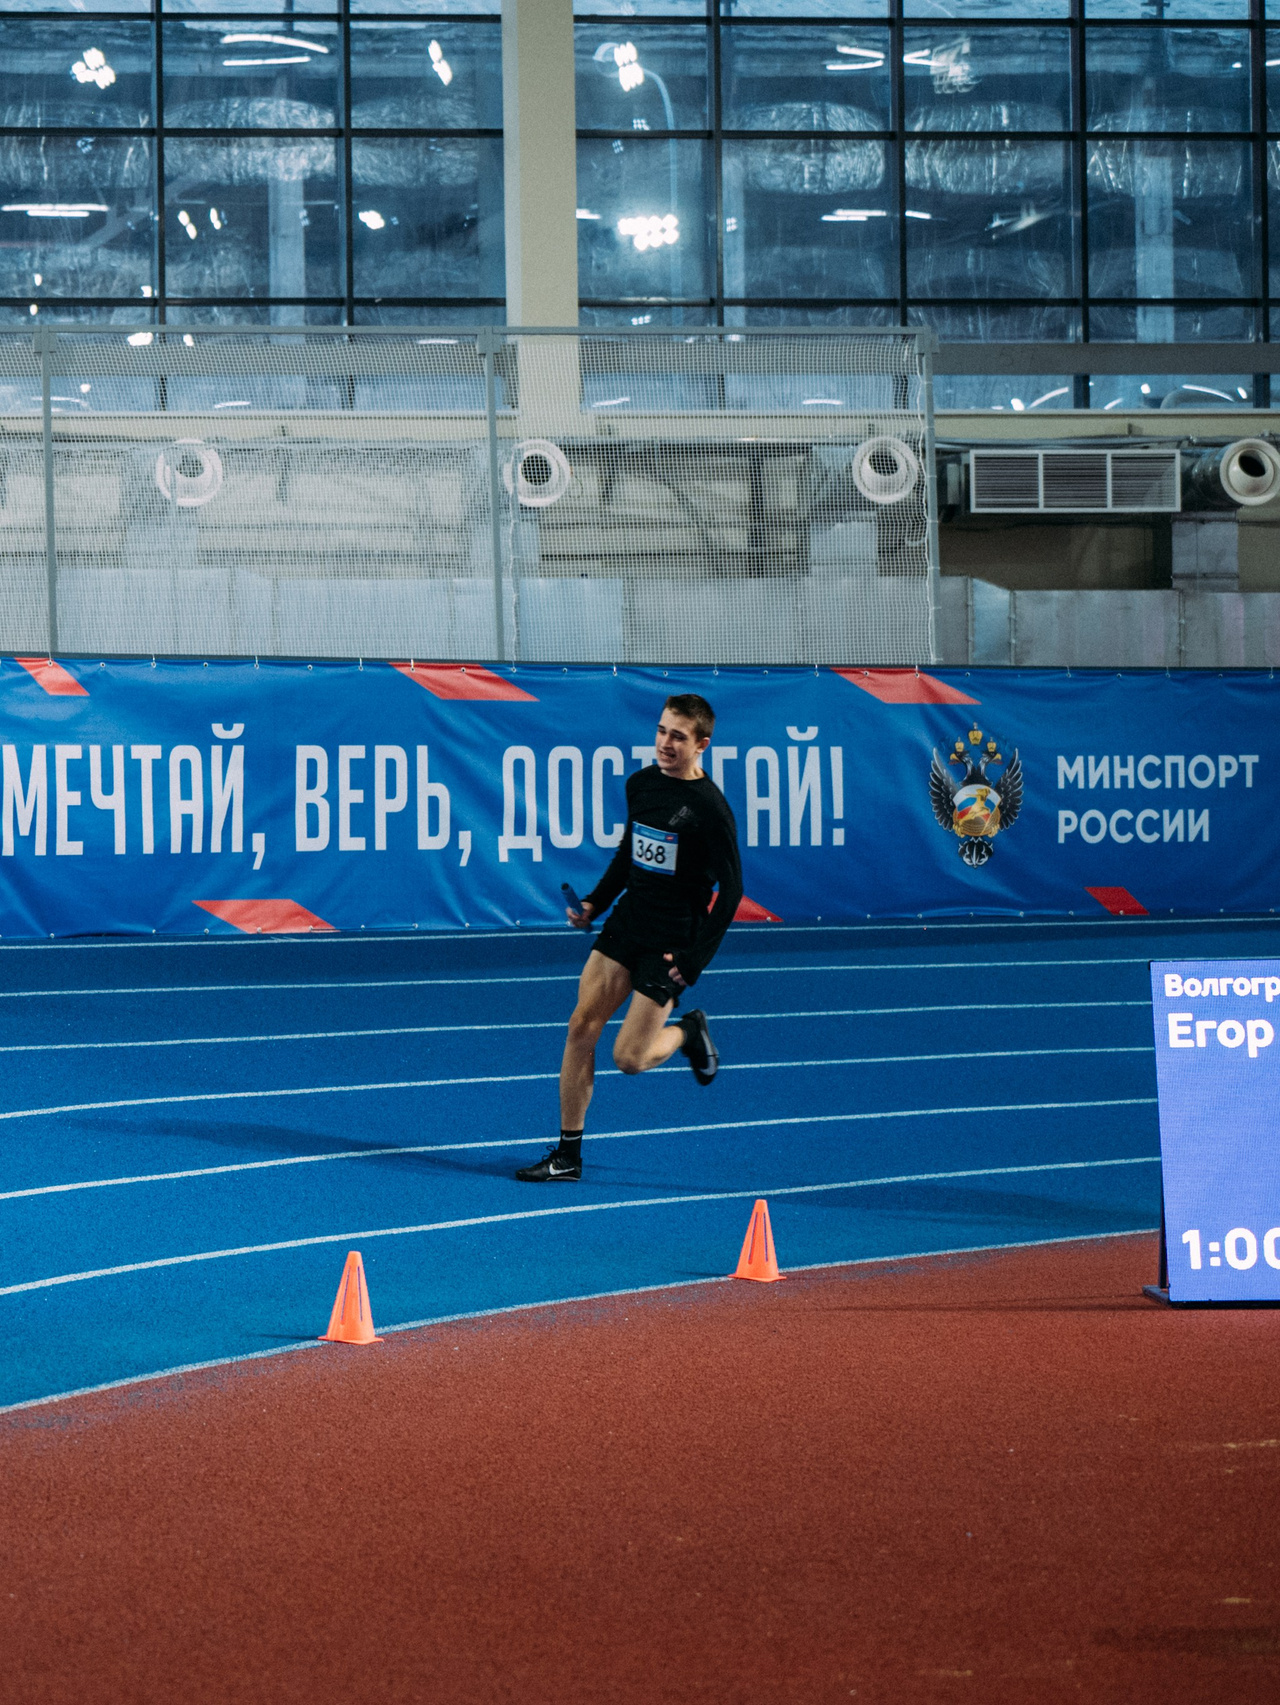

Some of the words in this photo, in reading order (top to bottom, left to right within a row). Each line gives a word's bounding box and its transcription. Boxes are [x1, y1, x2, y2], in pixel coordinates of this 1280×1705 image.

[1057, 754, 1260, 790] МИНСПОРТ
[2, 723, 266, 870] МЕЧТАЙ,
[295, 744, 472, 867] ВЕРЬ,
[1058, 808, 1210, 844] РОССИИ
[636, 839, 666, 864] 368
[1167, 1012, 1275, 1058] Егор
